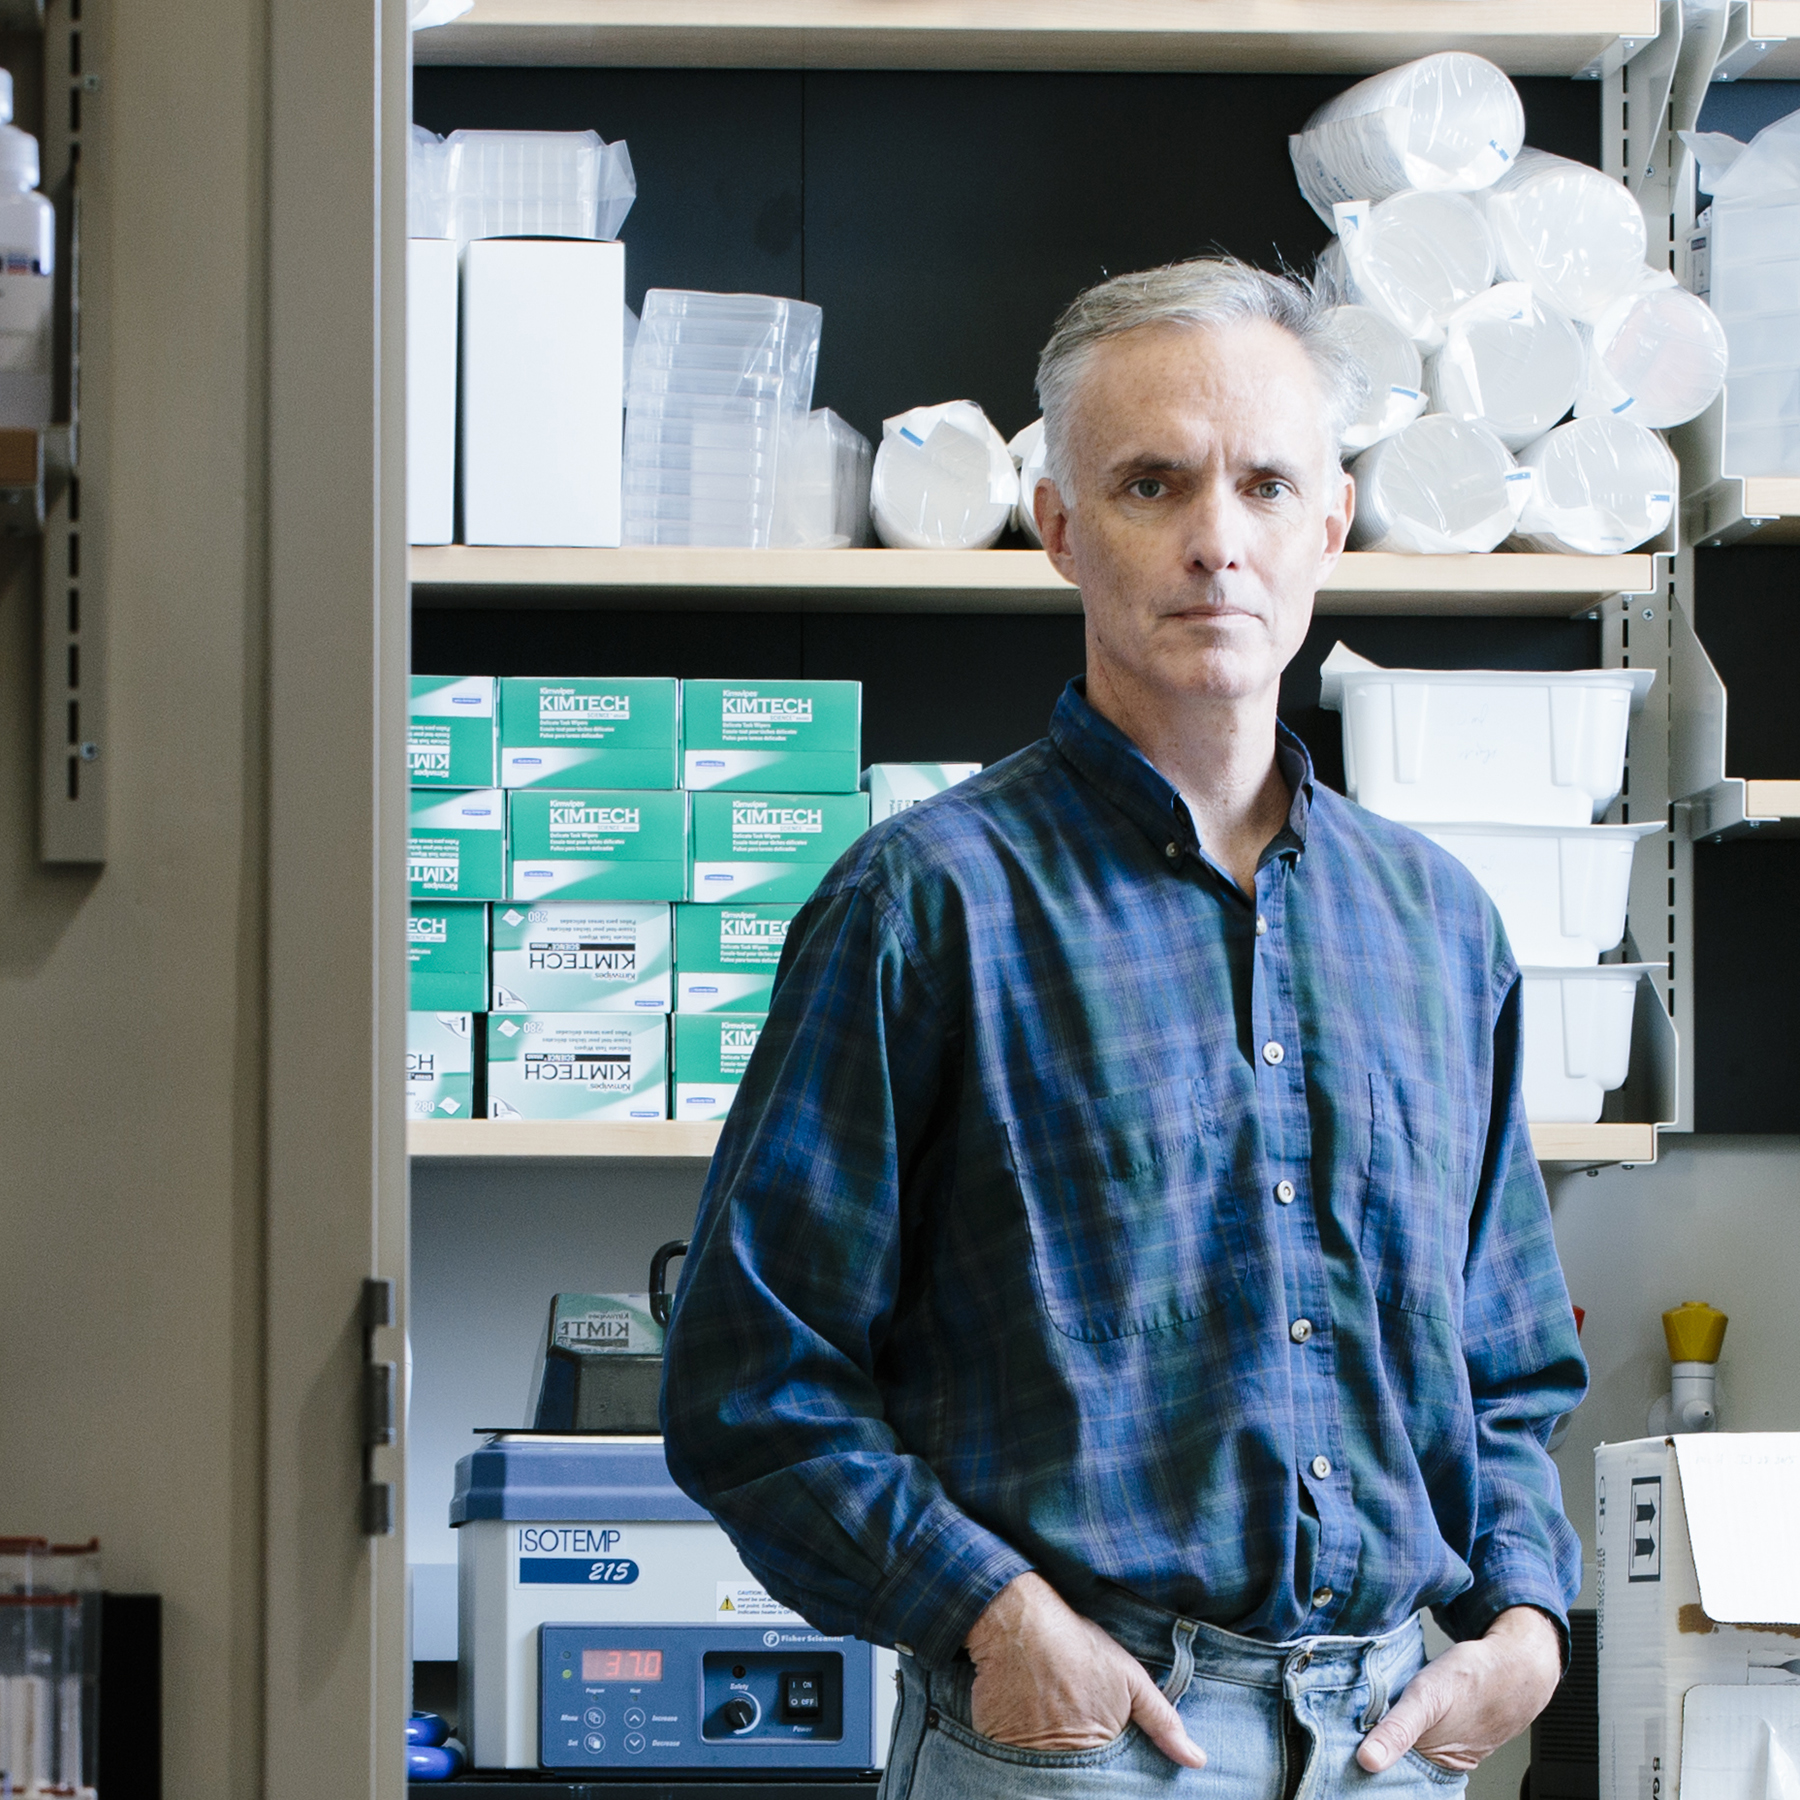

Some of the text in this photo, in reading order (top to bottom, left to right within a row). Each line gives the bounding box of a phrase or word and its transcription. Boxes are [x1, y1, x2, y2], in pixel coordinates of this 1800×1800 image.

[539, 696, 629, 712] KIMTECH
[722, 698, 812, 714] KIMTECH
[549, 808, 639, 824] KIMTECH
[732, 809, 822, 825] KIMTECH
[527, 910, 548, 923] 280
[408, 918, 447, 933] ECH
[721, 920, 792, 936] KIMTEC
[528, 953, 636, 970] KIMTECH
[594, 971, 636, 981] Kimwipes
[522, 1021, 544, 1034] 280
[524, 1063, 631, 1081] KIMTECH
[589, 1082, 631, 1091] Kimwipes
[414, 1100, 436, 1113] 280
[519, 1528, 621, 1553] ISOTEMP
[588, 1562, 630, 1581] 215
[730, 1683, 749, 1691] Safety
[802, 1681, 812, 1689] ON
[801, 1698, 815, 1706] OFF
[567, 1739, 579, 1747] Set
[652, 1739, 680, 1747] Decrease
